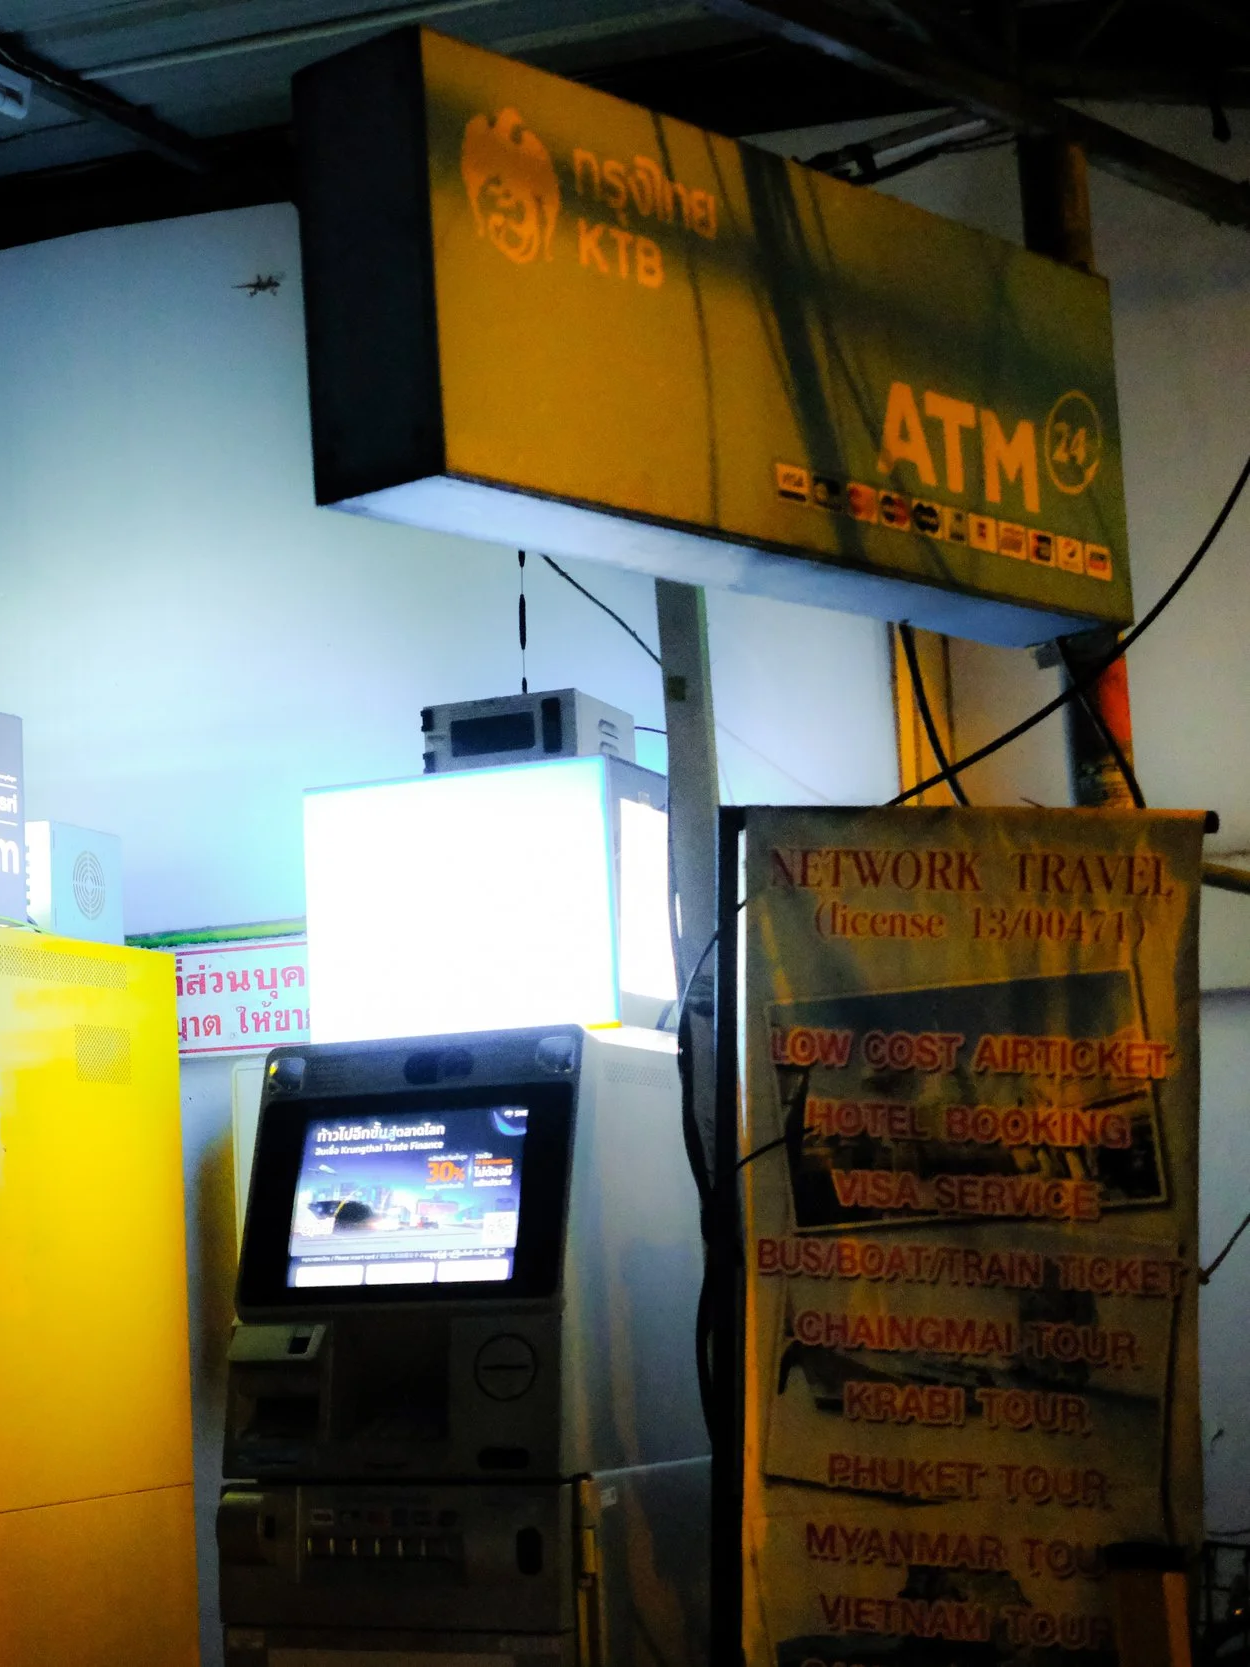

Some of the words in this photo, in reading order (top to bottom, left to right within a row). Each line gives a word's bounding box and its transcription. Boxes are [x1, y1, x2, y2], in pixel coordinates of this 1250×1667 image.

[577, 217, 665, 288] KTB
[876, 380, 1041, 513] ATM
[1050, 423, 1087, 465] 24
[770, 847, 983, 892] NETWORK
[1009, 851, 1174, 899] TRAVEL
[814, 900, 946, 940] (license
[970, 904, 1146, 949] 13/00471)
[236, 1000, 310, 1035] ให้ขา
[772, 1028, 852, 1067] LOW
[863, 1031, 965, 1072] COST
[974, 1035, 1173, 1080] AIRTICKET
[340, 1144, 383, 1155] Krungthai
[384, 1142, 409, 1152] Trade
[410, 1141, 444, 1151] Finance
[805, 1097, 930, 1140] HOTEL
[946, 1104, 1133, 1149] BOOKING
[426, 1161, 465, 1182] 30%
[833, 1168, 924, 1209] VISA
[934, 1174, 1102, 1219] SERVICE
[757, 1238, 1044, 1287] BUS/BOAT/TRAIN
[796, 1310, 1016, 1358] CHAINGMAI
[1026, 1321, 1141, 1368] TOUR
[844, 1381, 967, 1427] KRABI
[975, 1388, 1093, 1436] TOUR
[827, 1452, 989, 1498] PHUKET
[1000, 1463, 1114, 1508] TOUR
[805, 1522, 1006, 1571] MYANMAR
[1022, 1537, 1107, 1579] TOU
[818, 1594, 991, 1642] VIETNAM
[1004, 1605, 1114, 1650] TOUR
